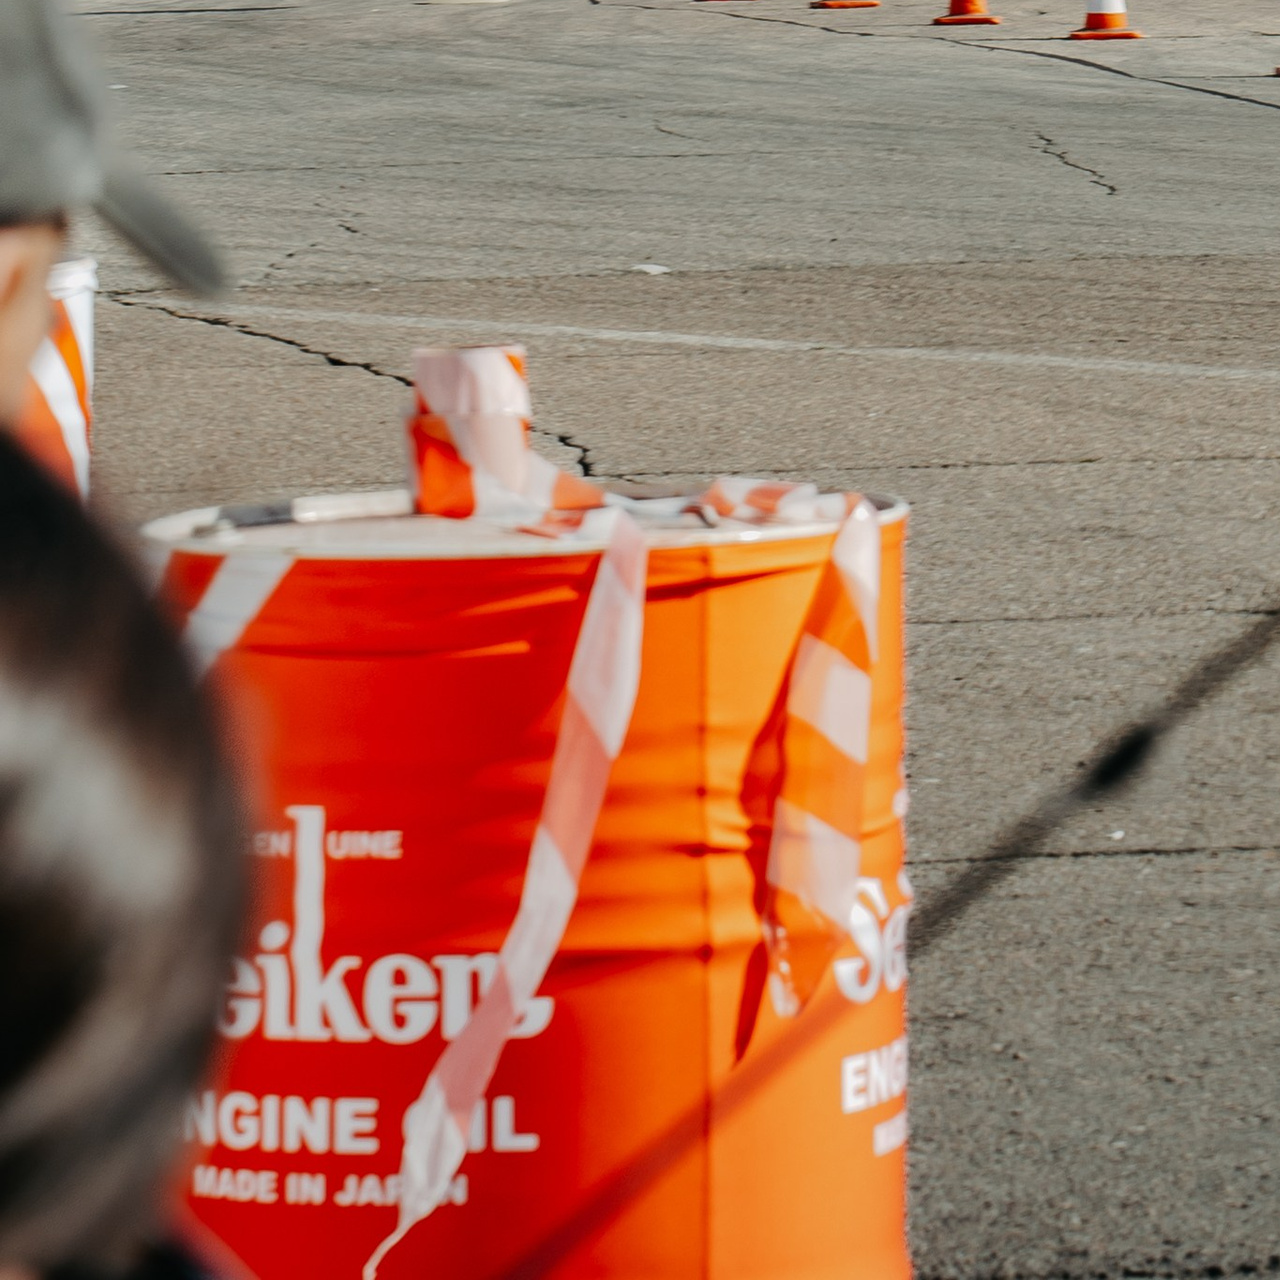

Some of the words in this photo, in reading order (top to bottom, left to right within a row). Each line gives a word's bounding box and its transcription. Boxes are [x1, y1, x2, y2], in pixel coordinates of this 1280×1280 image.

[216, 804, 556, 1045] eiken
[184, 1089, 380, 1155] NGINE
[402, 1094, 541, 1154] IL
[192, 1164, 279, 1204] MADE
[285, 1172, 327, 1206] IN
